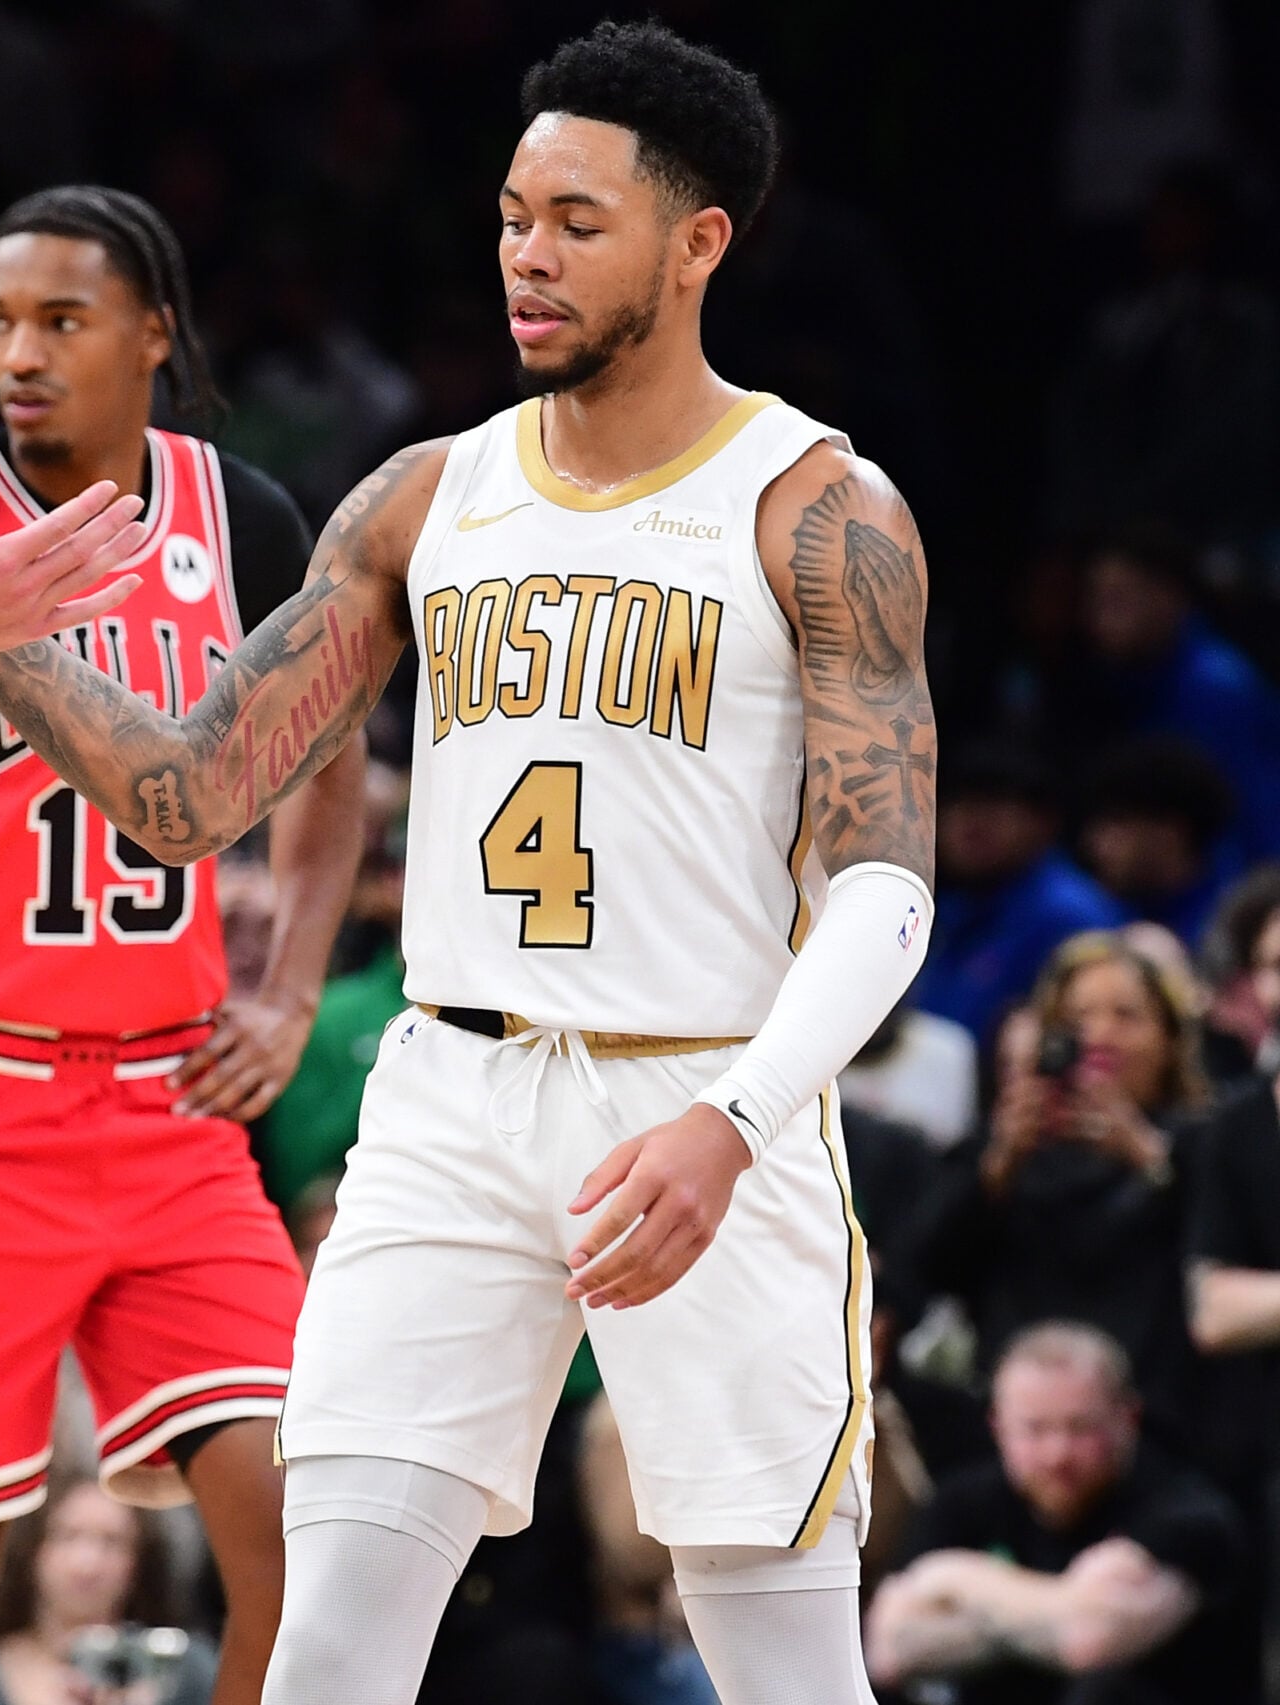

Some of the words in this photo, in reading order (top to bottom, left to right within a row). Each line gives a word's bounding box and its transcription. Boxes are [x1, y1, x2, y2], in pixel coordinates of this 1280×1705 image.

[632, 510, 722, 540] Amica
[215, 605, 377, 827] Family
[424, 574, 724, 752] BOSTON
[153, 783, 173, 833] T-MAC
[479, 761, 595, 949] 4
